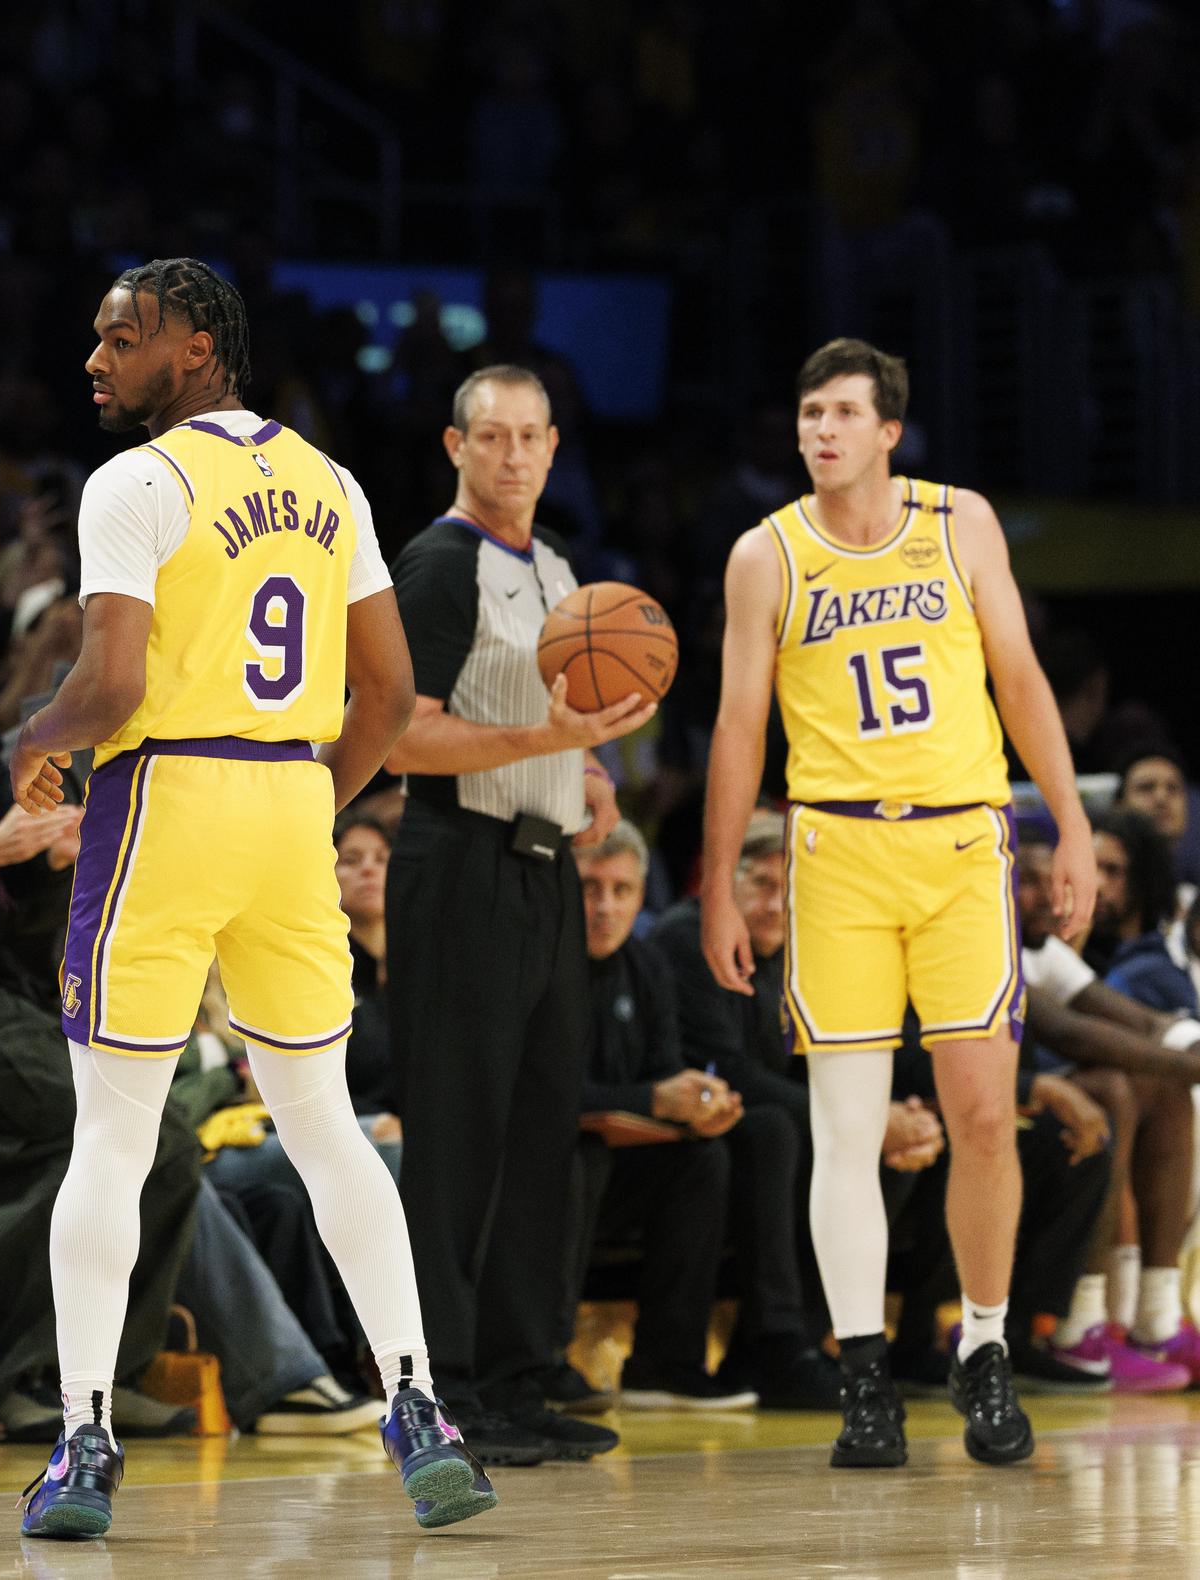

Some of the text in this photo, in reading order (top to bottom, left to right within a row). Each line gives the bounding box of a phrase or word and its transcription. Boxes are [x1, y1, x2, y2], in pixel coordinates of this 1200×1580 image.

[213, 489, 341, 560] JAMES JR.
[242, 573, 307, 712] 9
[800, 579, 948, 646] LAKERS
[847, 642, 933, 740] 15
